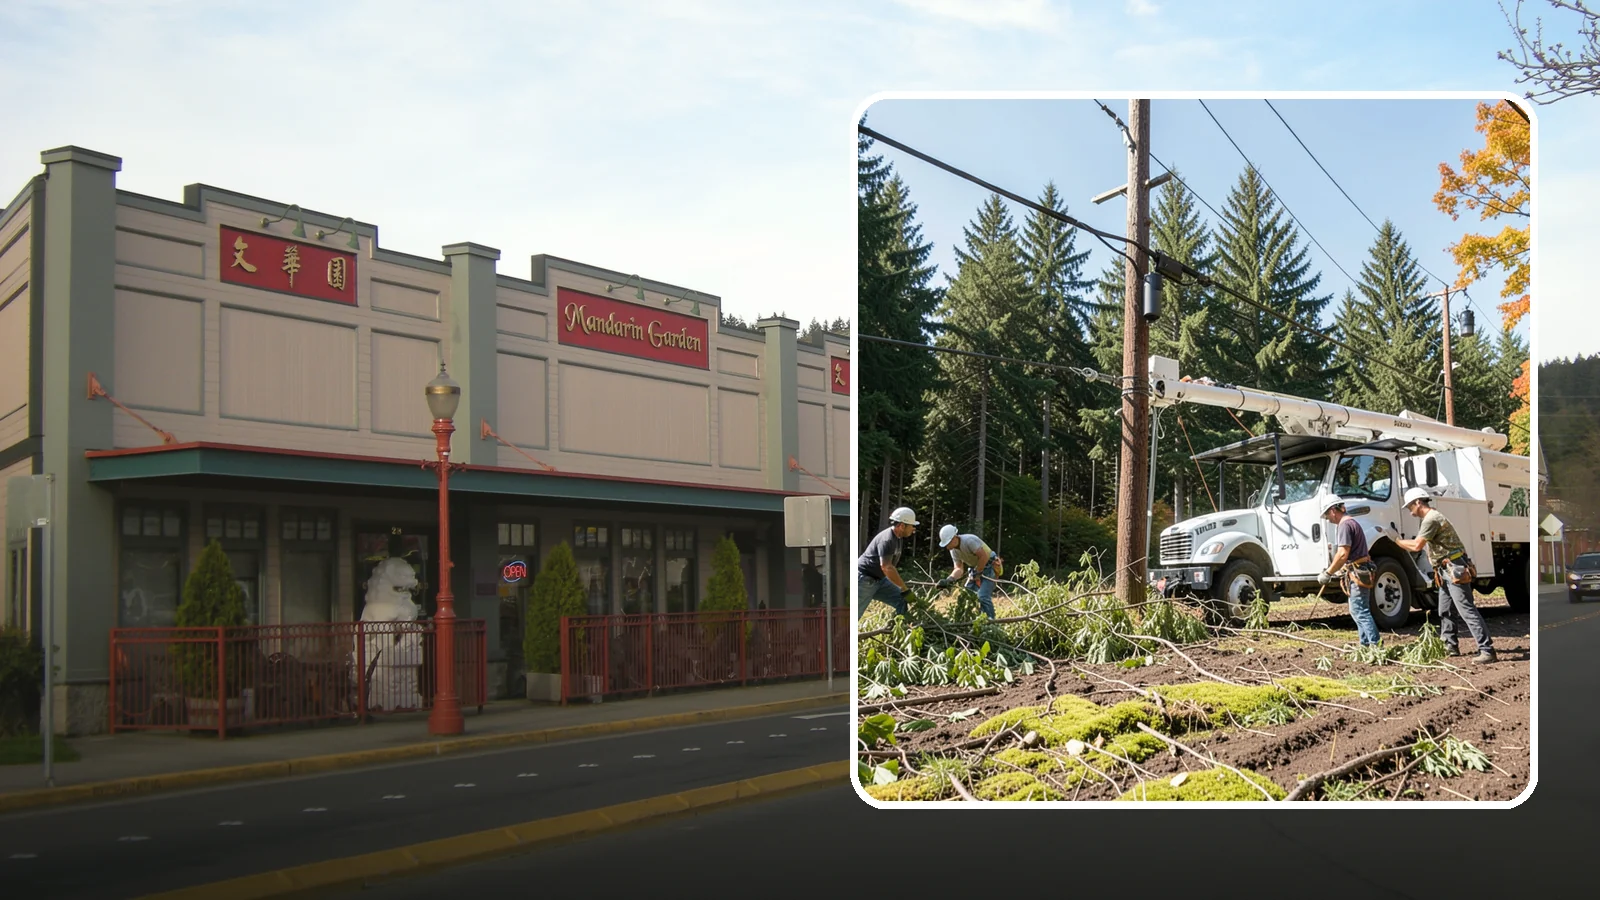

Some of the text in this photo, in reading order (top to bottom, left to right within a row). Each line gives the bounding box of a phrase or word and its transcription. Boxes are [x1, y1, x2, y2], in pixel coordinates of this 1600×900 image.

[231, 235, 346, 291] 文華園
[564, 302, 702, 352] Mandarin Garden
[834, 363, 846, 386] 文
[503, 565, 527, 578] OPEN
